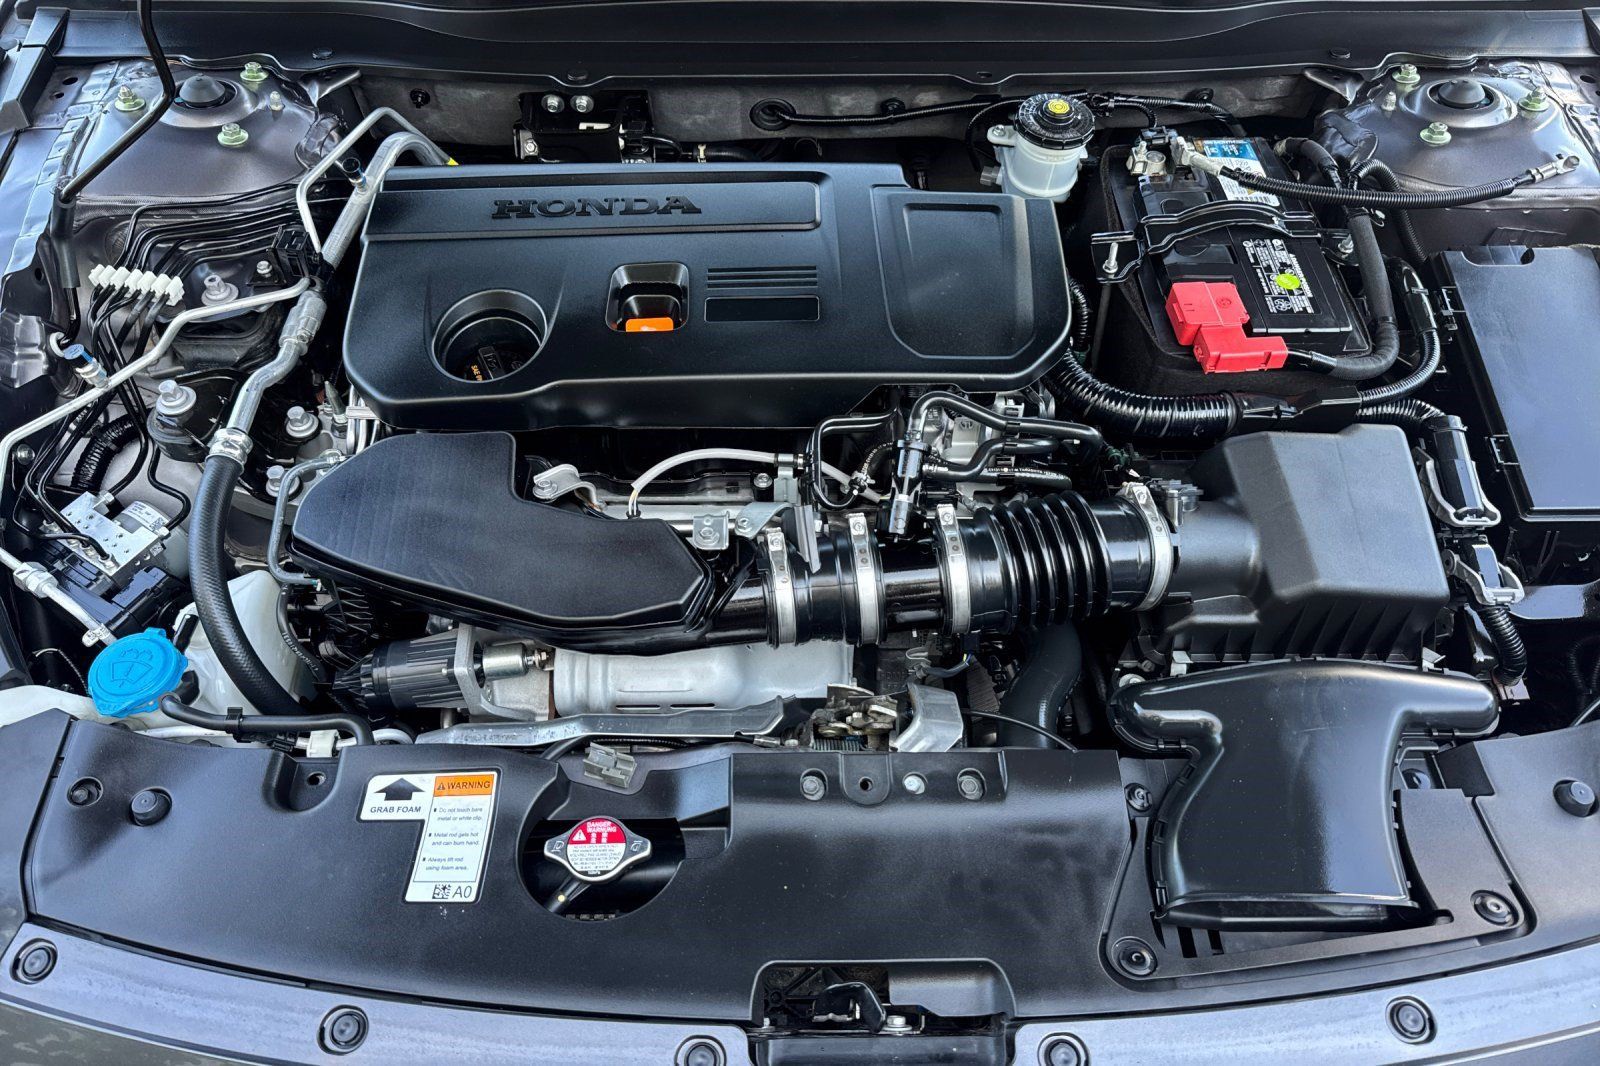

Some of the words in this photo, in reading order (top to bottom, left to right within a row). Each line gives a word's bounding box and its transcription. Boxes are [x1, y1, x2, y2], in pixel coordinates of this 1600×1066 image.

[491, 195, 702, 219] HONDA
[447, 781, 491, 790] WARNING
[452, 885, 473, 899] A0
